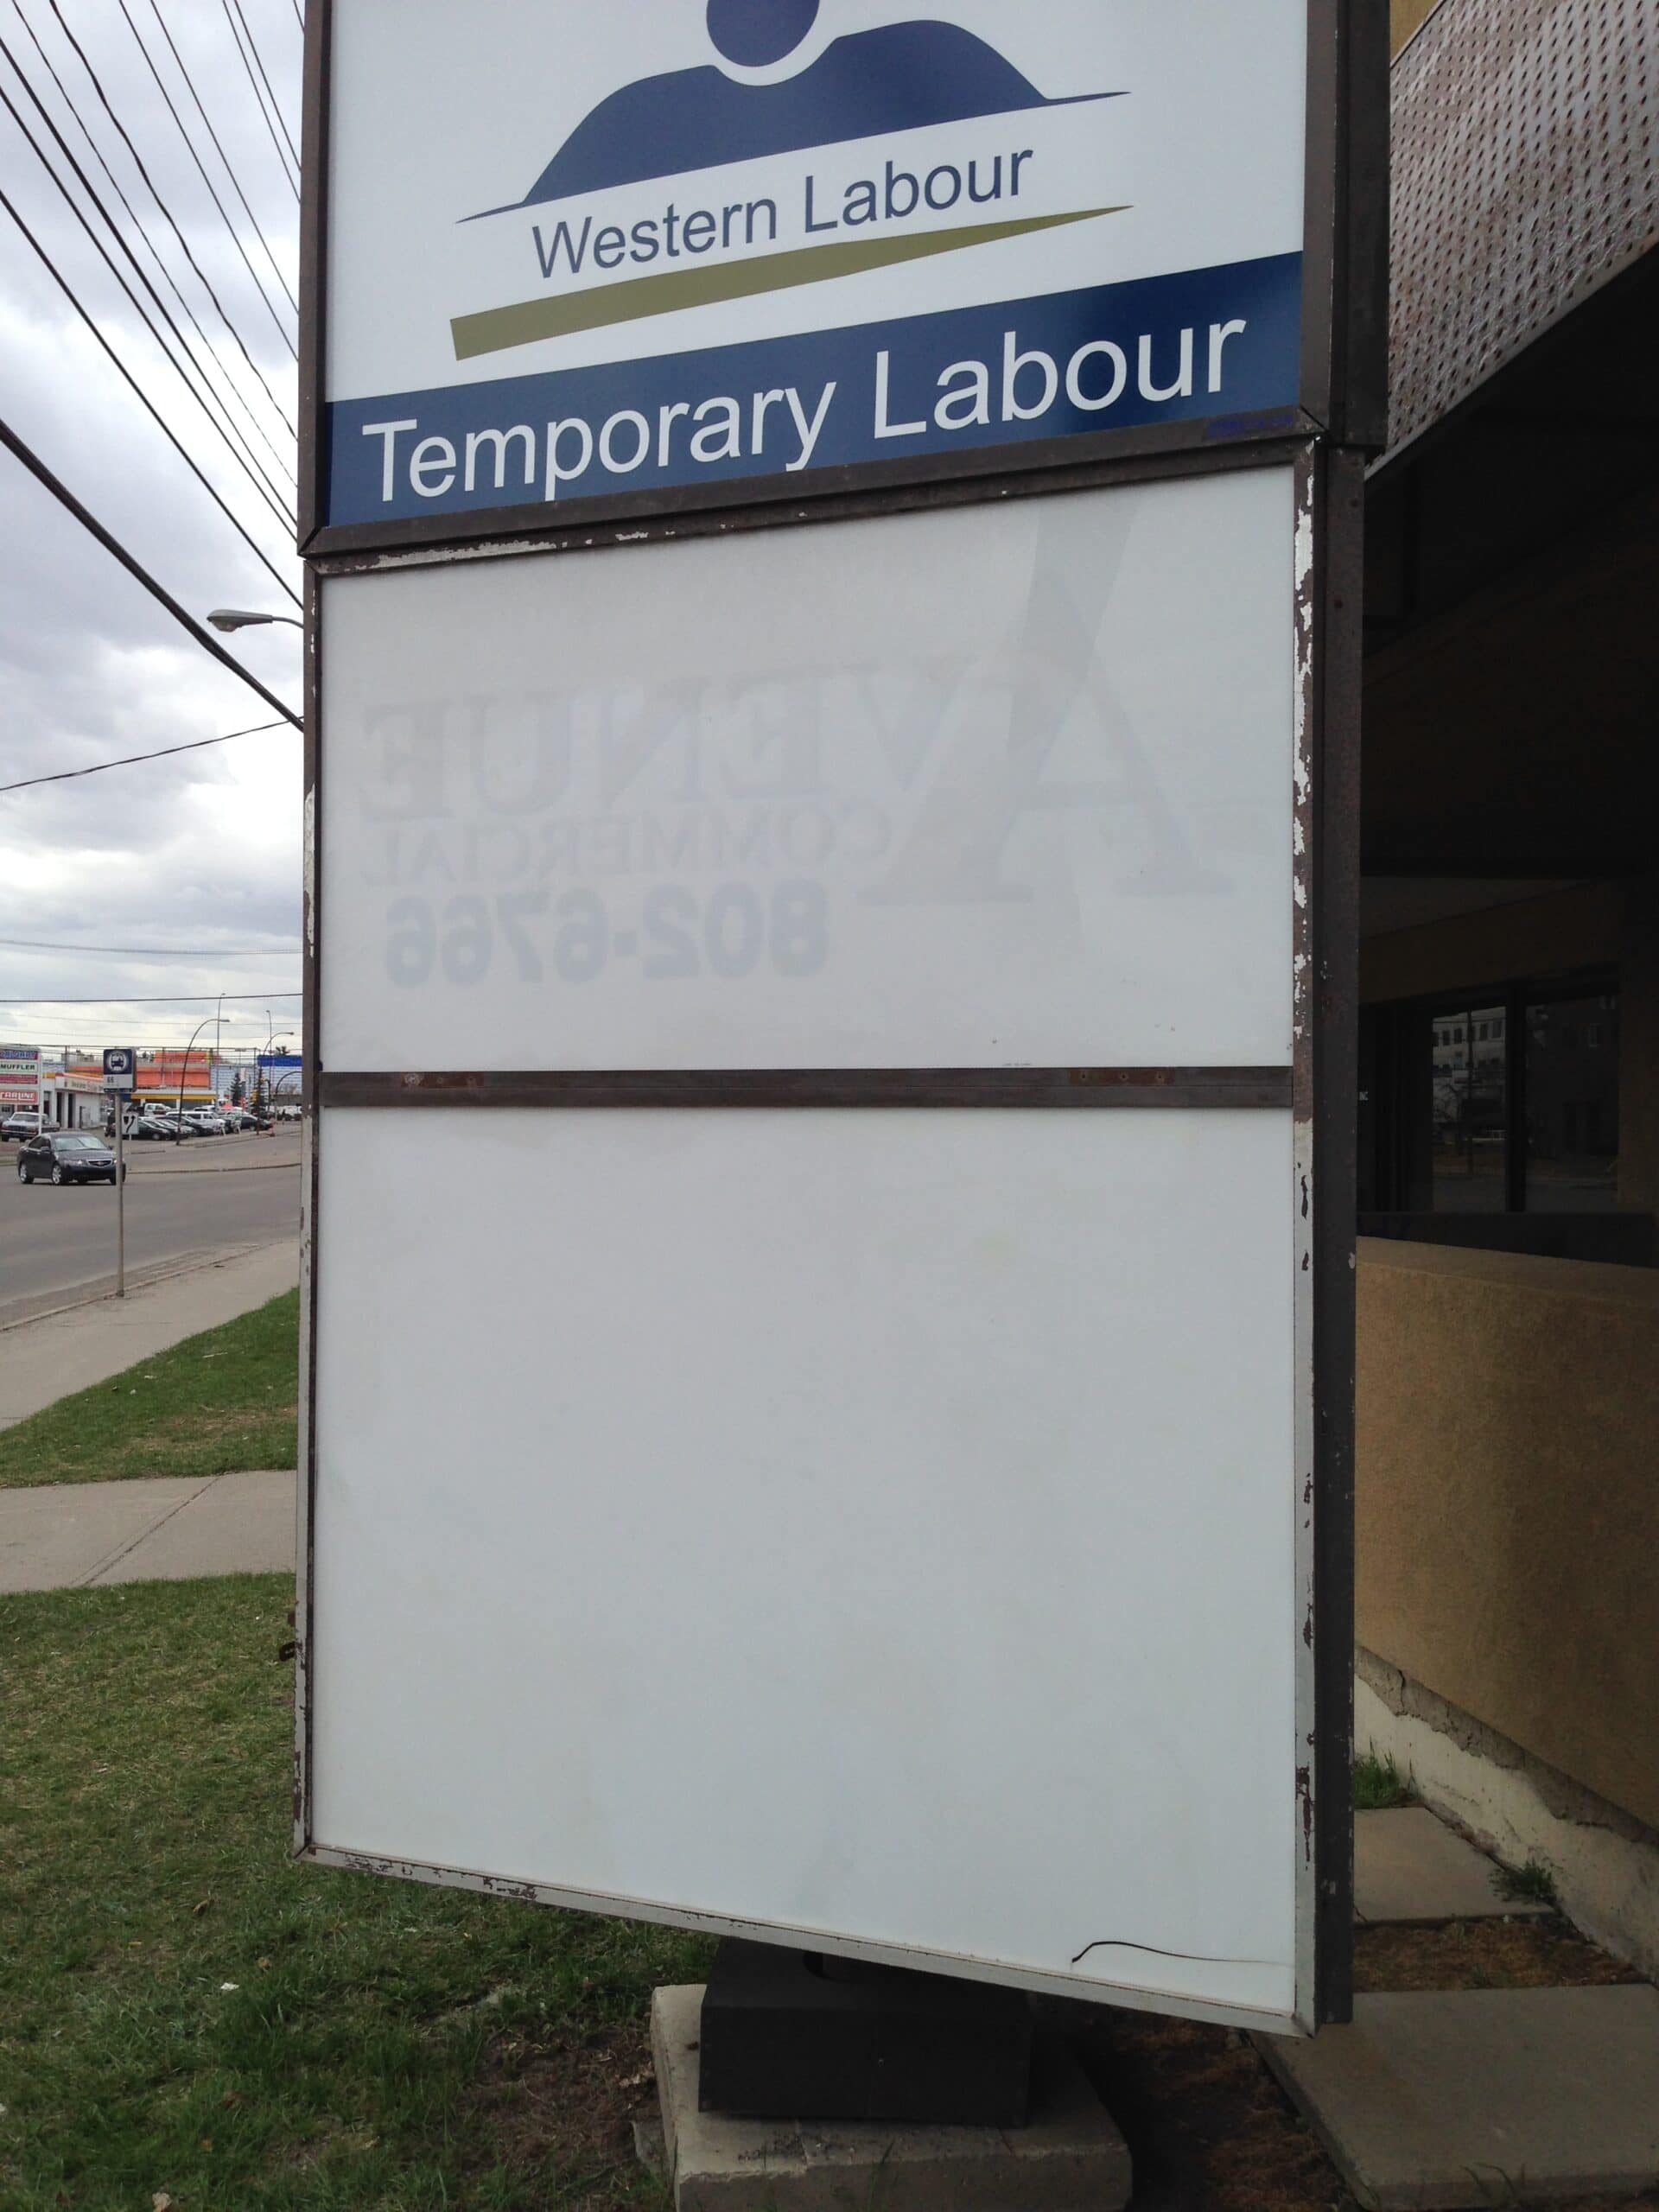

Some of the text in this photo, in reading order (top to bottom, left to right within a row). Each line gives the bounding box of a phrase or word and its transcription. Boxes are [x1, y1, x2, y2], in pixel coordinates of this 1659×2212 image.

[531, 149, 1035, 280] Western Labour
[361, 318, 1248, 503] Temporary Labour
